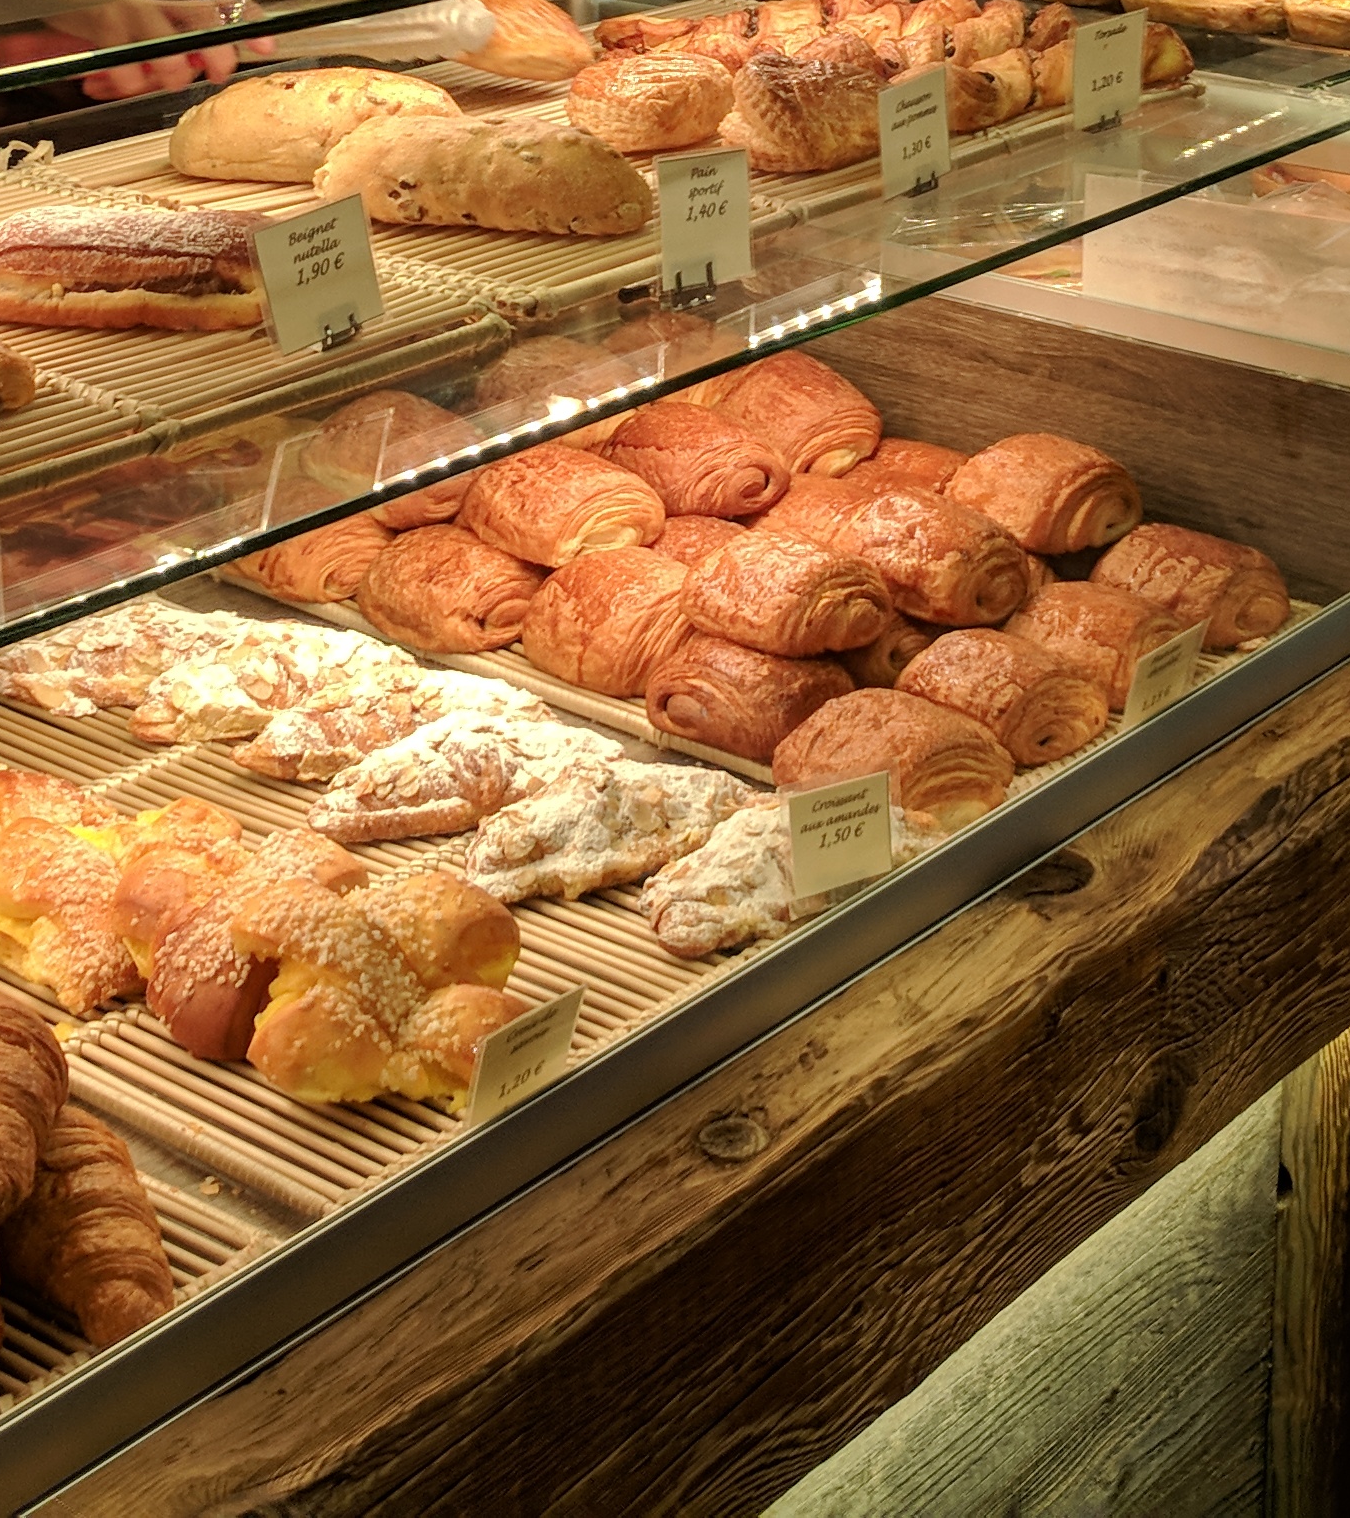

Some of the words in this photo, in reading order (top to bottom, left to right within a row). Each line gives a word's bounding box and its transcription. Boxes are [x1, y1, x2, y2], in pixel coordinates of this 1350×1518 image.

[925, 135, 932, 149] €
[690, 166, 718, 180] Pain
[688, 180, 725, 201] sportif
[685, 202, 716, 222] 1,40
[719, 200, 729, 215] €
[288, 217, 339, 246] Beignet
[293, 237, 341, 264] nutella
[297, 258, 331, 286] 1,90
[334, 252, 345, 270] €
[800, 820, 825, 834] aux
[826, 802, 882, 826] amandes
[819, 825, 851, 849] 1,50
[854, 821, 866, 838] €
[499, 1068, 531, 1099] 1,20
[534, 1059, 546, 1076] €
